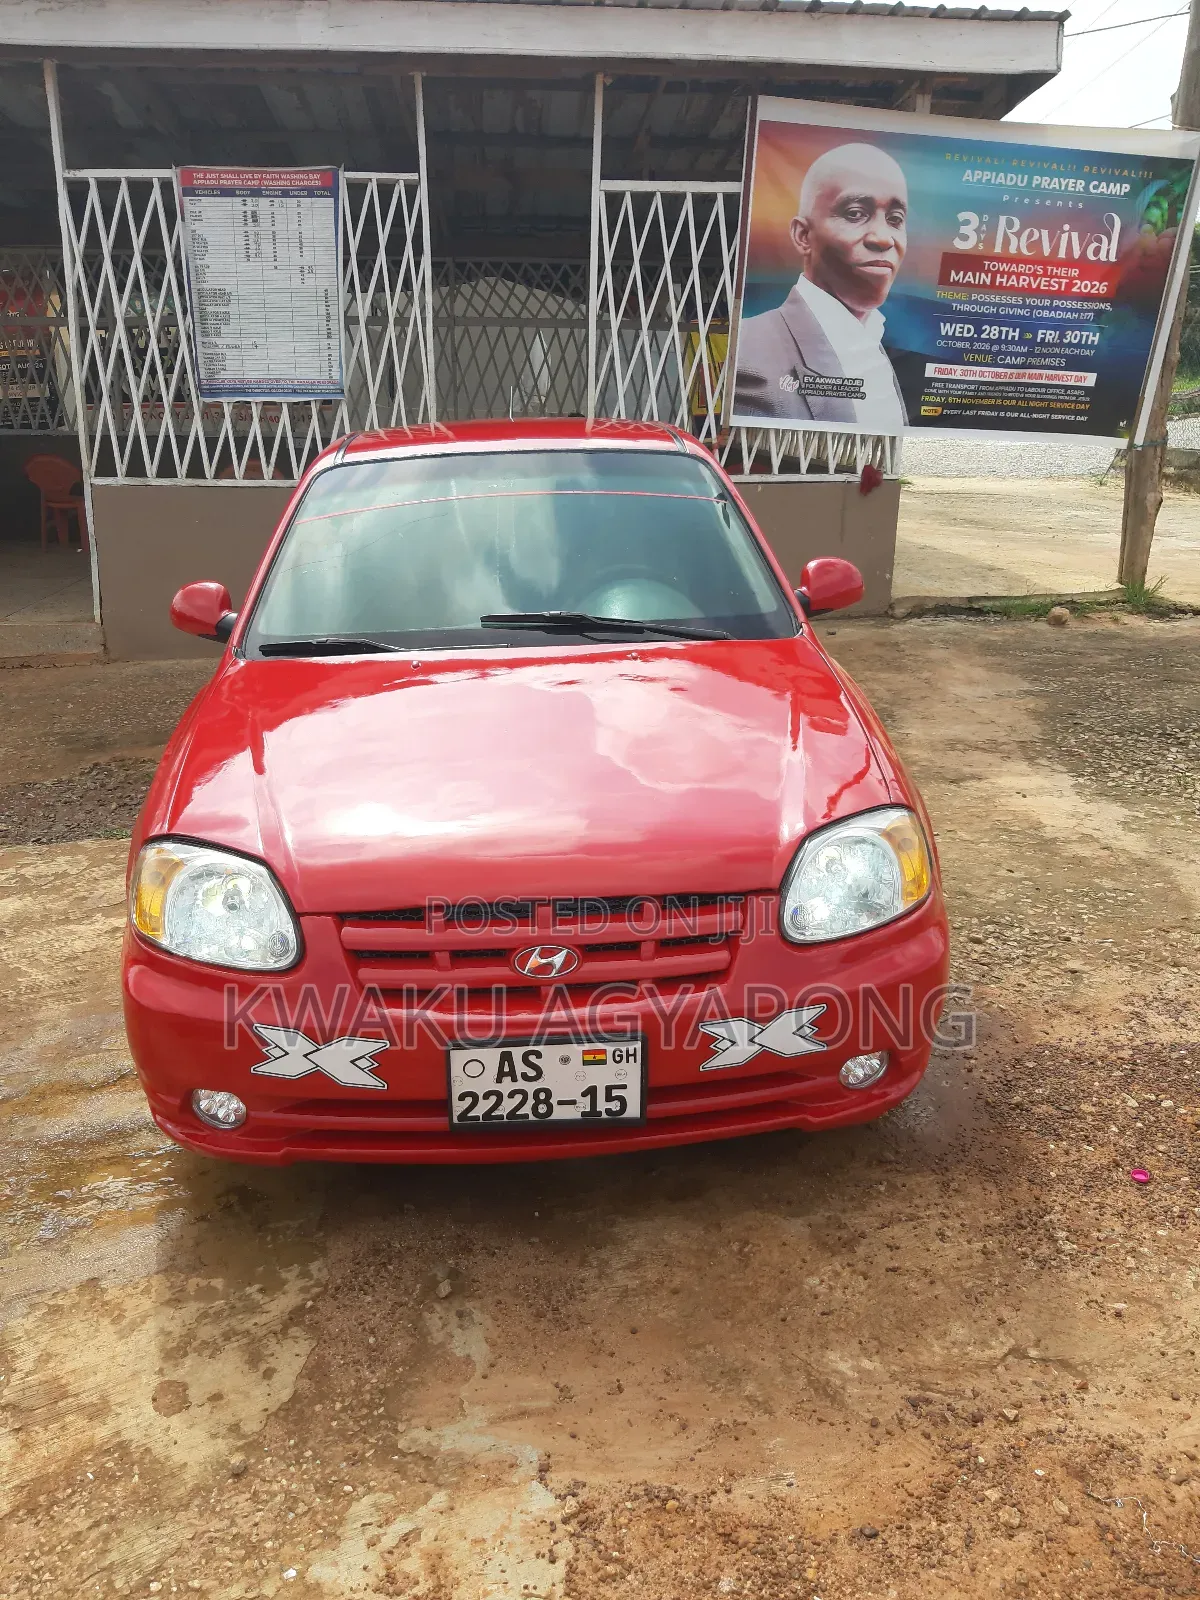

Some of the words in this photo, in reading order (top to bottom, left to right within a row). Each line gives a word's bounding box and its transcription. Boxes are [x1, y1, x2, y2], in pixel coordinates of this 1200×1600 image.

[962, 169, 1027, 187] APPIADU
[1032, 176, 1084, 192] PRAYER
[1089, 181, 1131, 196] CAMP
[952, 211, 980, 250] 3
[978, 214, 989, 250] DAYS
[994, 212, 1122, 262] Revival
[983, 261, 1043, 275] TOWARD'S
[1047, 266, 1079, 277] THEIR
[950, 270, 992, 285] MAIN
[995, 274, 1067, 292] HARVEST
[1071, 280, 1108, 294] 2026
[936, 290, 970, 300] THEME:
[971, 294, 1023, 305] POSSESSES
[1025, 297, 1050, 307] YOUR
[1052, 300, 1113, 312] POSSESSIONS,
[952, 303, 997, 314] THROUGH
[999, 307, 1031, 316] GIVING
[1033, 309, 1078, 320] (OBADIAH
[940, 322, 977, 338] WED.
[980, 325, 1020, 341] 28TH
[1062, 330, 1100, 345] 30TH
[936, 340, 972, 350] OCTOBER,
[973, 342, 991, 351] 2026
[992, 344, 999, 353] @
[1001, 344, 1028, 353] 9:30AM
[1041, 347, 1061, 355] NOON
[1061, 347, 1080, 356] EACH
[1080, 348, 1096, 357] DAY
[963, 353, 995, 363] VENUE:
[997, 355, 1025, 365] CAMP
[1026, 357, 1066, 367] PREMISES
[934, 367, 957, 377] FRIDAY,
[960, 369, 977, 377] 30TH
[979, 370, 1008, 379] OCTOBER
[1045, 373, 1073, 382] HARVEST
[1074, 375, 1088, 383] DAY
[946, 382, 978, 390] TRANSPORT
[921, 395, 947, 403] FRIDAY,
[496, 1050, 543, 1084] AS
[612, 1047, 637, 1064] GH
